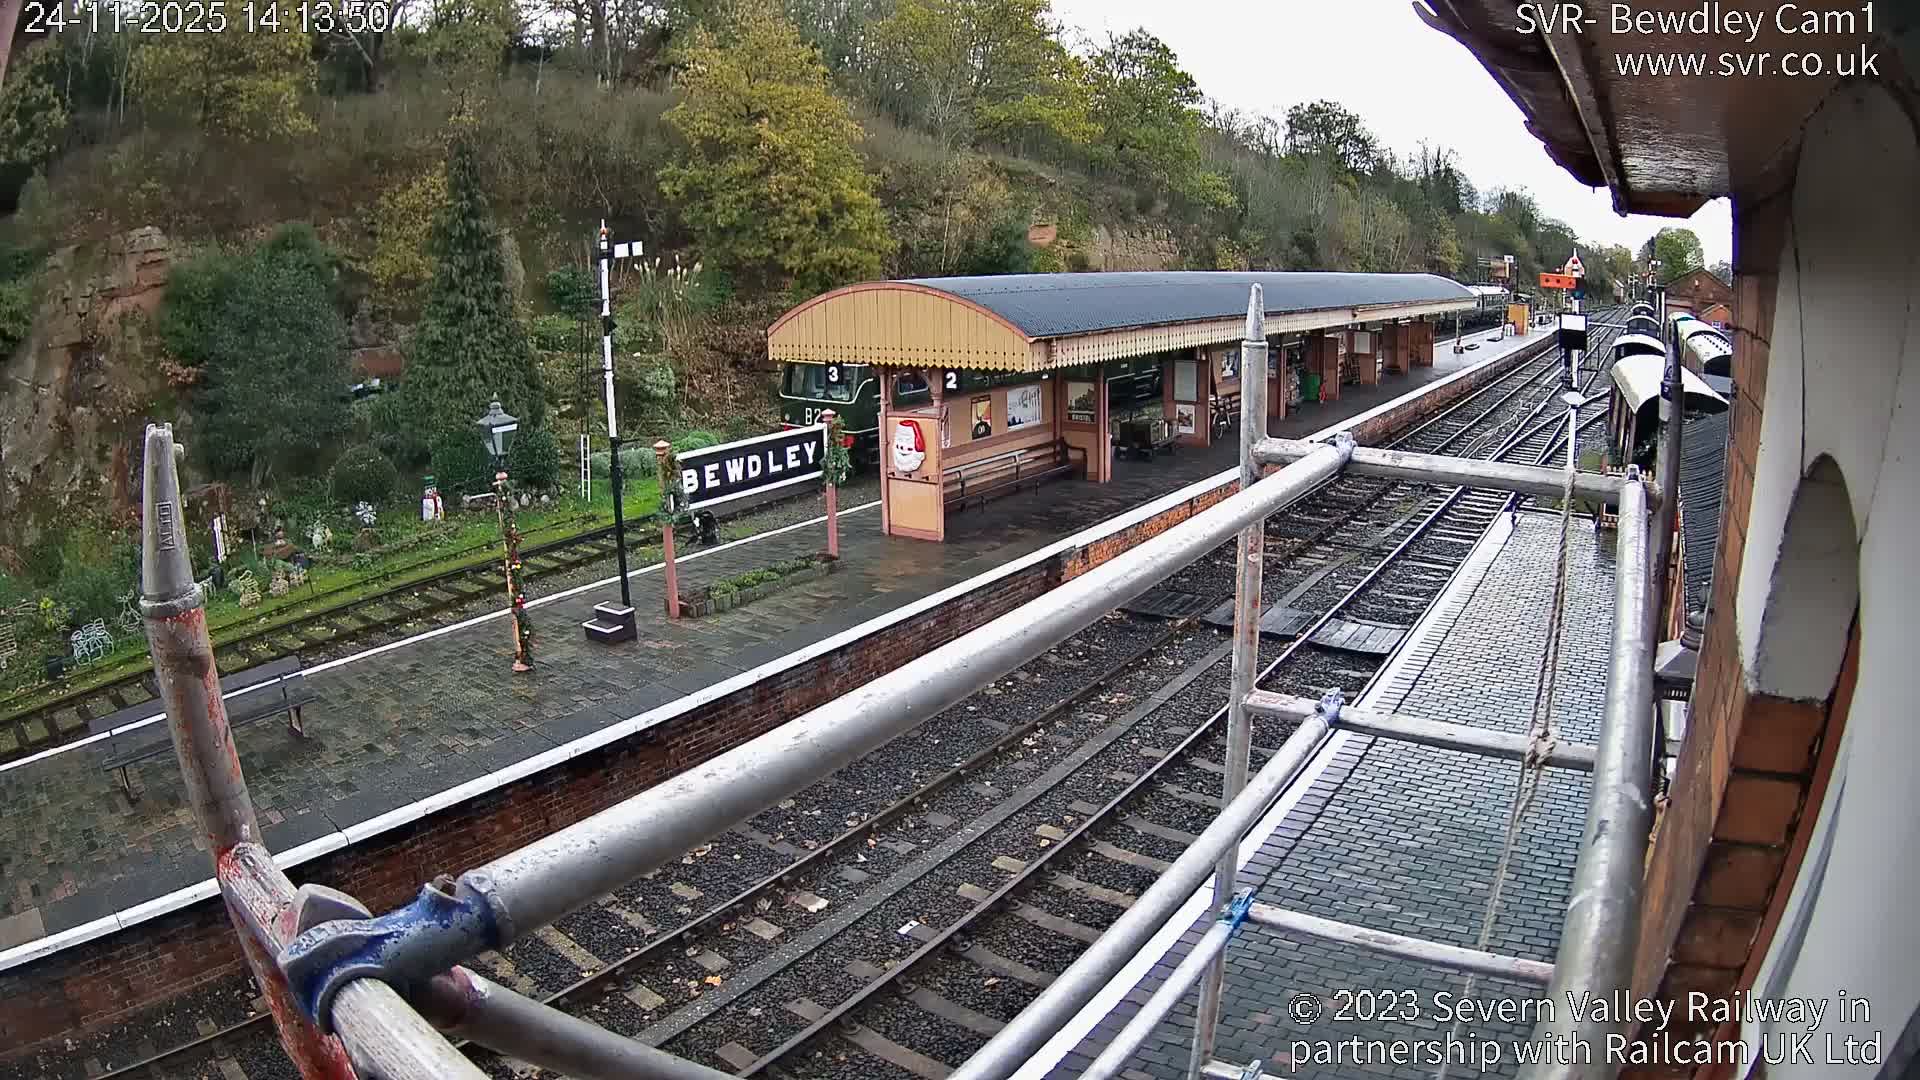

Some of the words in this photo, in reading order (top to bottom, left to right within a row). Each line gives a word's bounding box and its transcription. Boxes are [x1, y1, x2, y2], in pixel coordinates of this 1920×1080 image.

[828, 366, 839, 382] 3
[945, 372, 957, 389] 2
[681, 440, 817, 494] BEWDLEY
